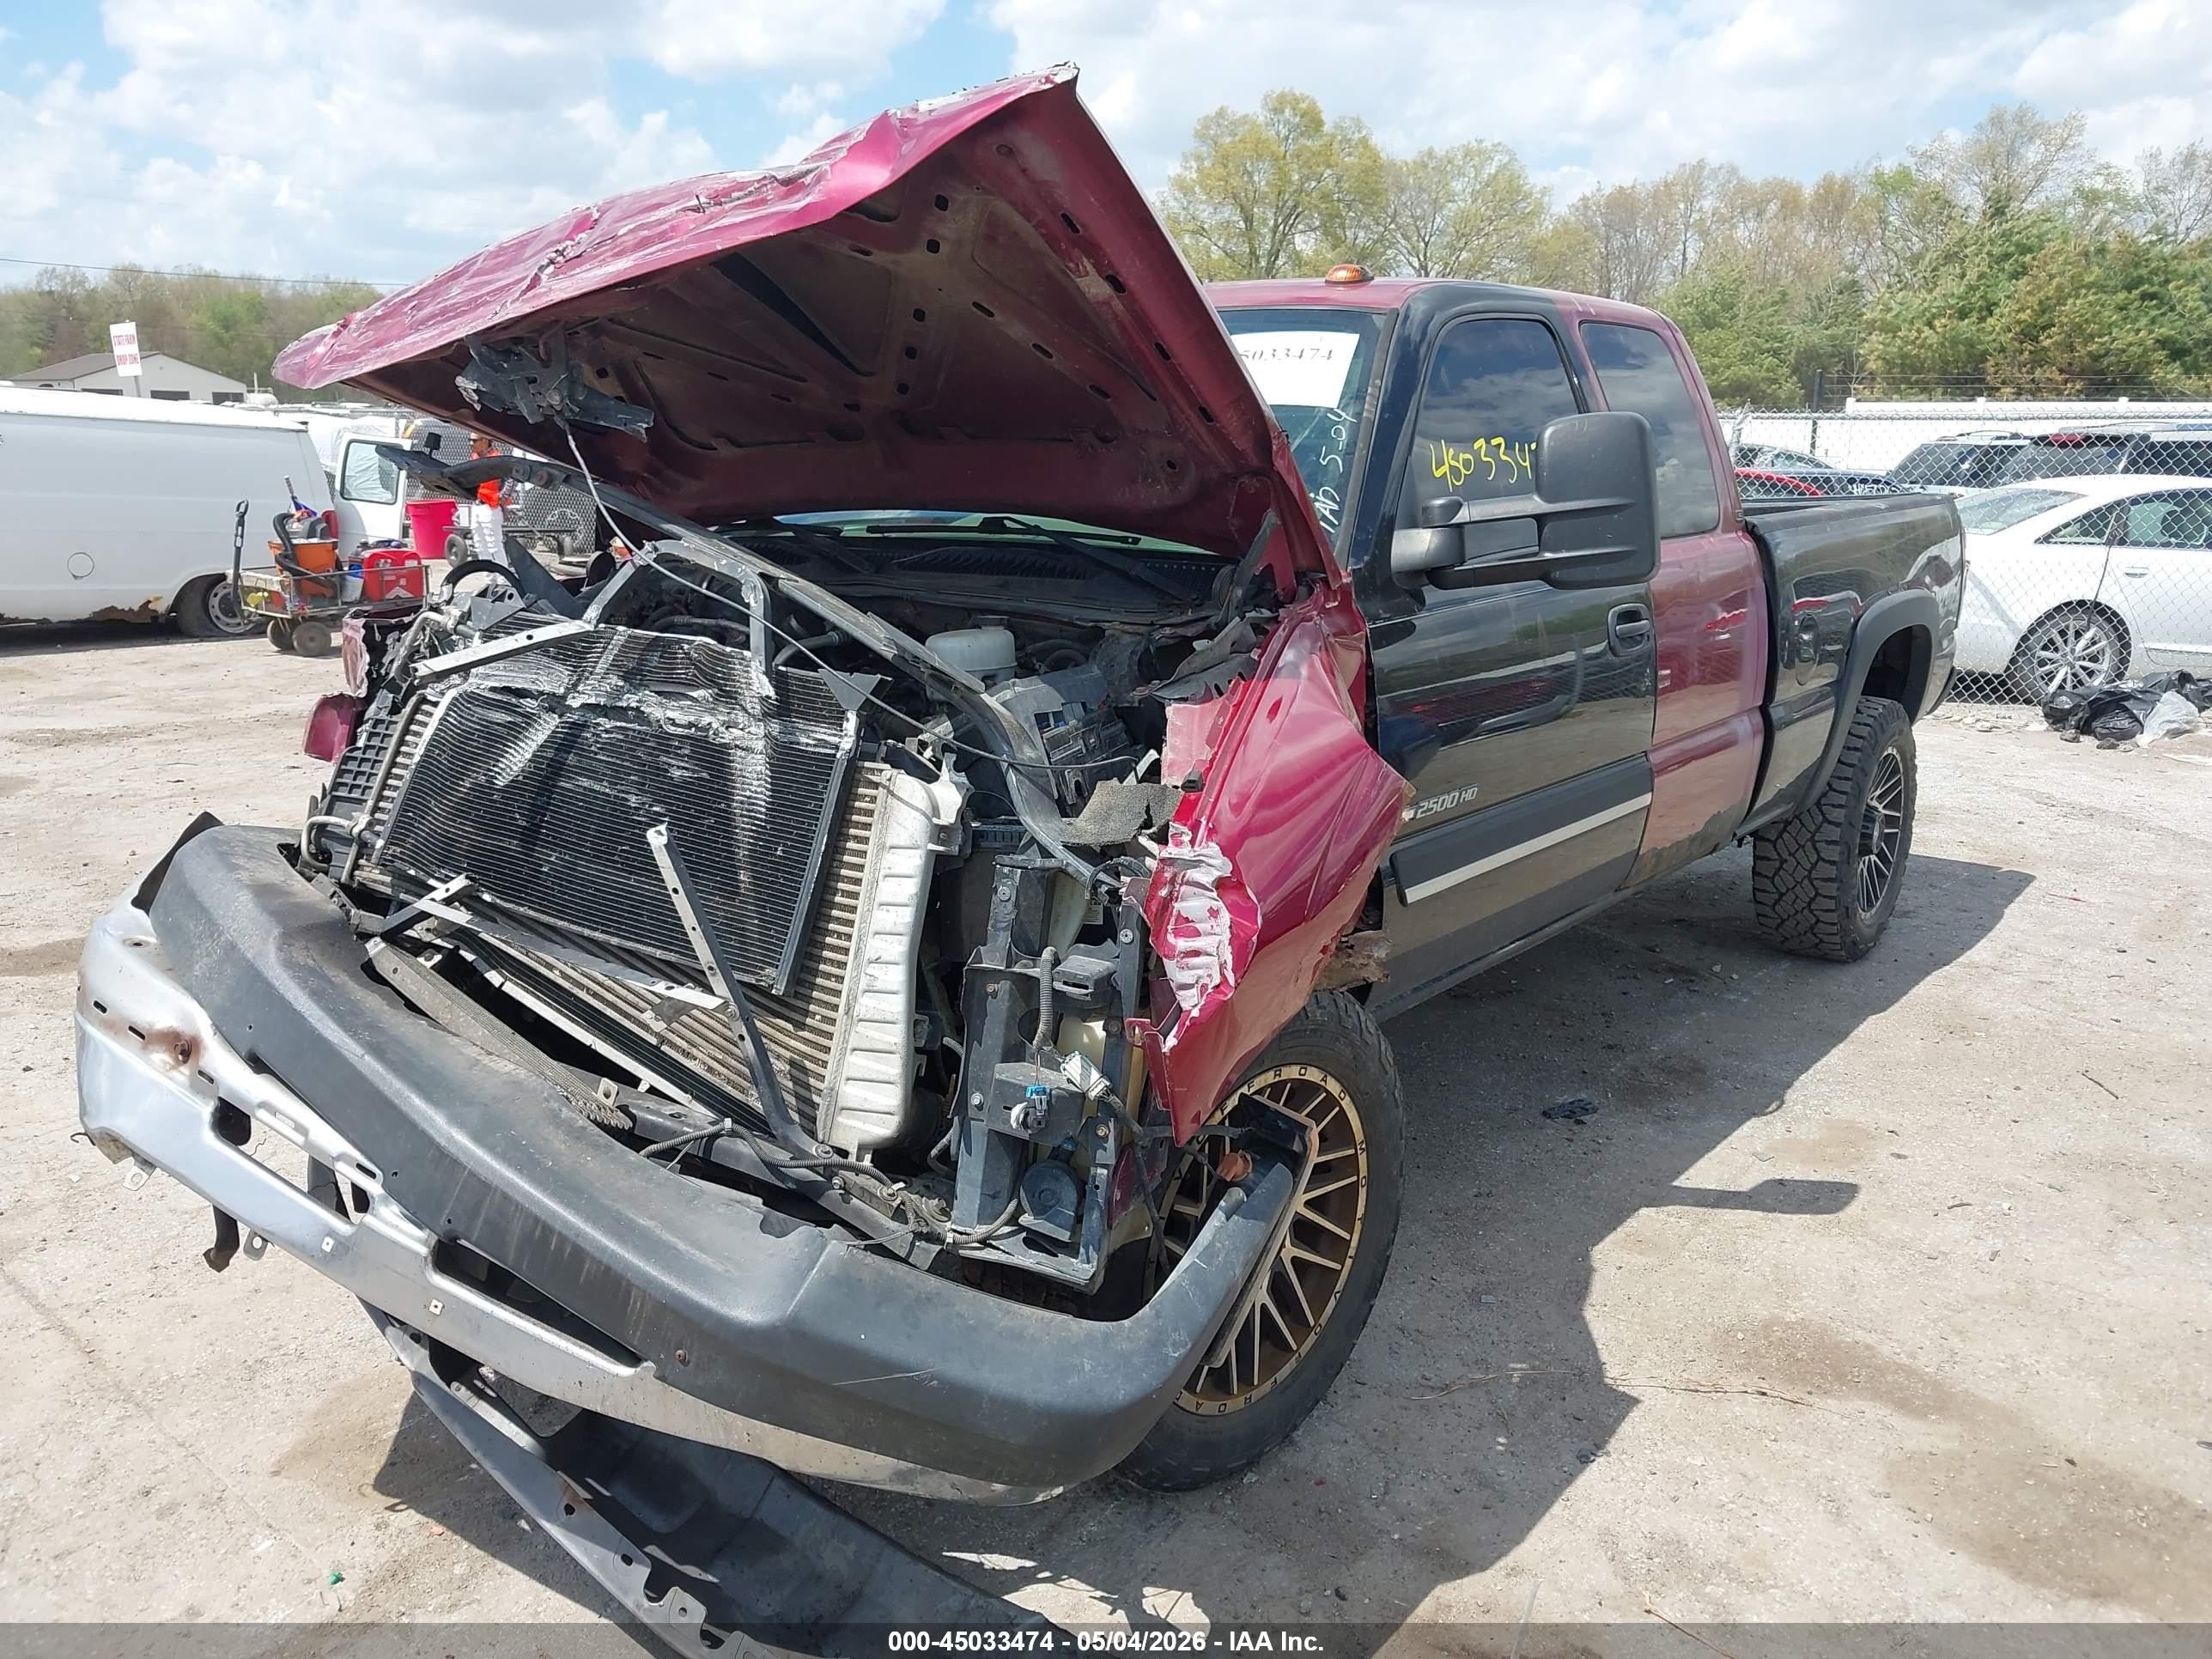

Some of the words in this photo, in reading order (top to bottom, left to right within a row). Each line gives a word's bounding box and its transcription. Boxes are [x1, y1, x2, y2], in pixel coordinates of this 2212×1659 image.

[1429, 436, 1537, 492] 450334
[1416, 792, 1459, 819] 2500
[1460, 787, 1478, 804] HD
